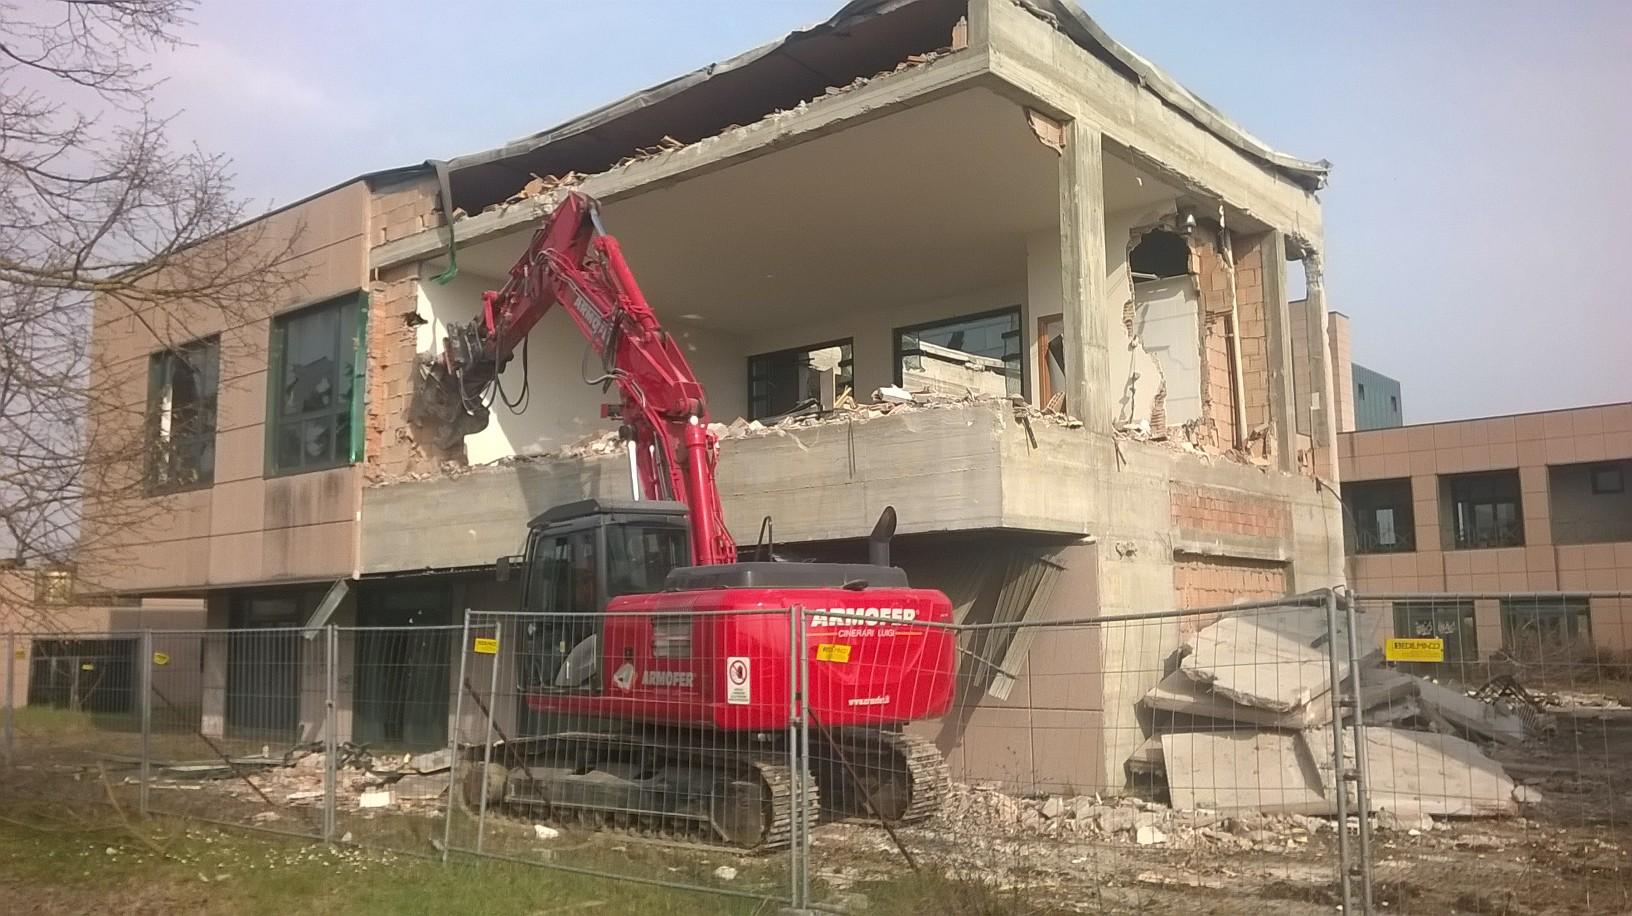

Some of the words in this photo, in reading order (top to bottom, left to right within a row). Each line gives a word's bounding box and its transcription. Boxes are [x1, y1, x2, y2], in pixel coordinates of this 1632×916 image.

[811, 607, 916, 627] ARMOFER
[838, 629, 874, 638] CINERARI
[877, 629, 895, 637] LUIGI
[641, 671, 694, 687] ARMOFER
